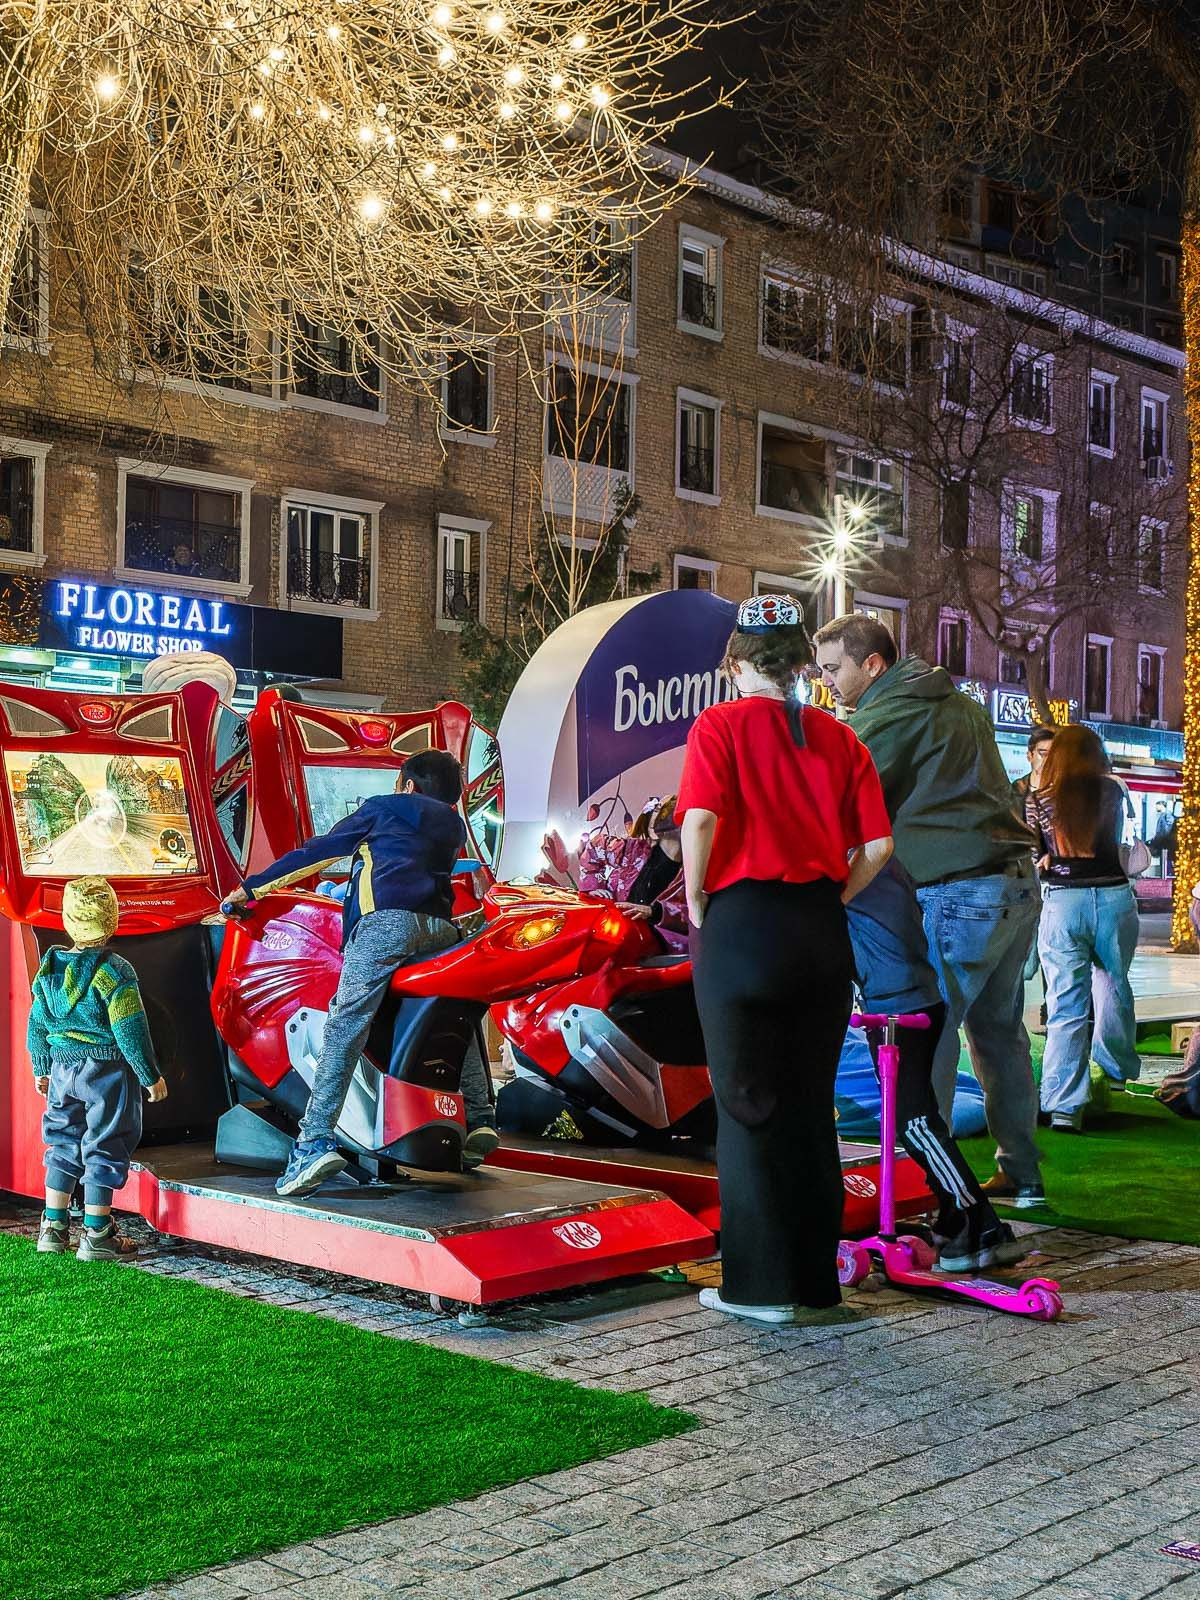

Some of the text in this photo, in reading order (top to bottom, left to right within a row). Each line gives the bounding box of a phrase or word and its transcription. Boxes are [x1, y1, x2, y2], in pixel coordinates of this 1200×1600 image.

[57, 582, 232, 635] FLOREAL
[78, 626, 203, 656] FLOWER SHOP
